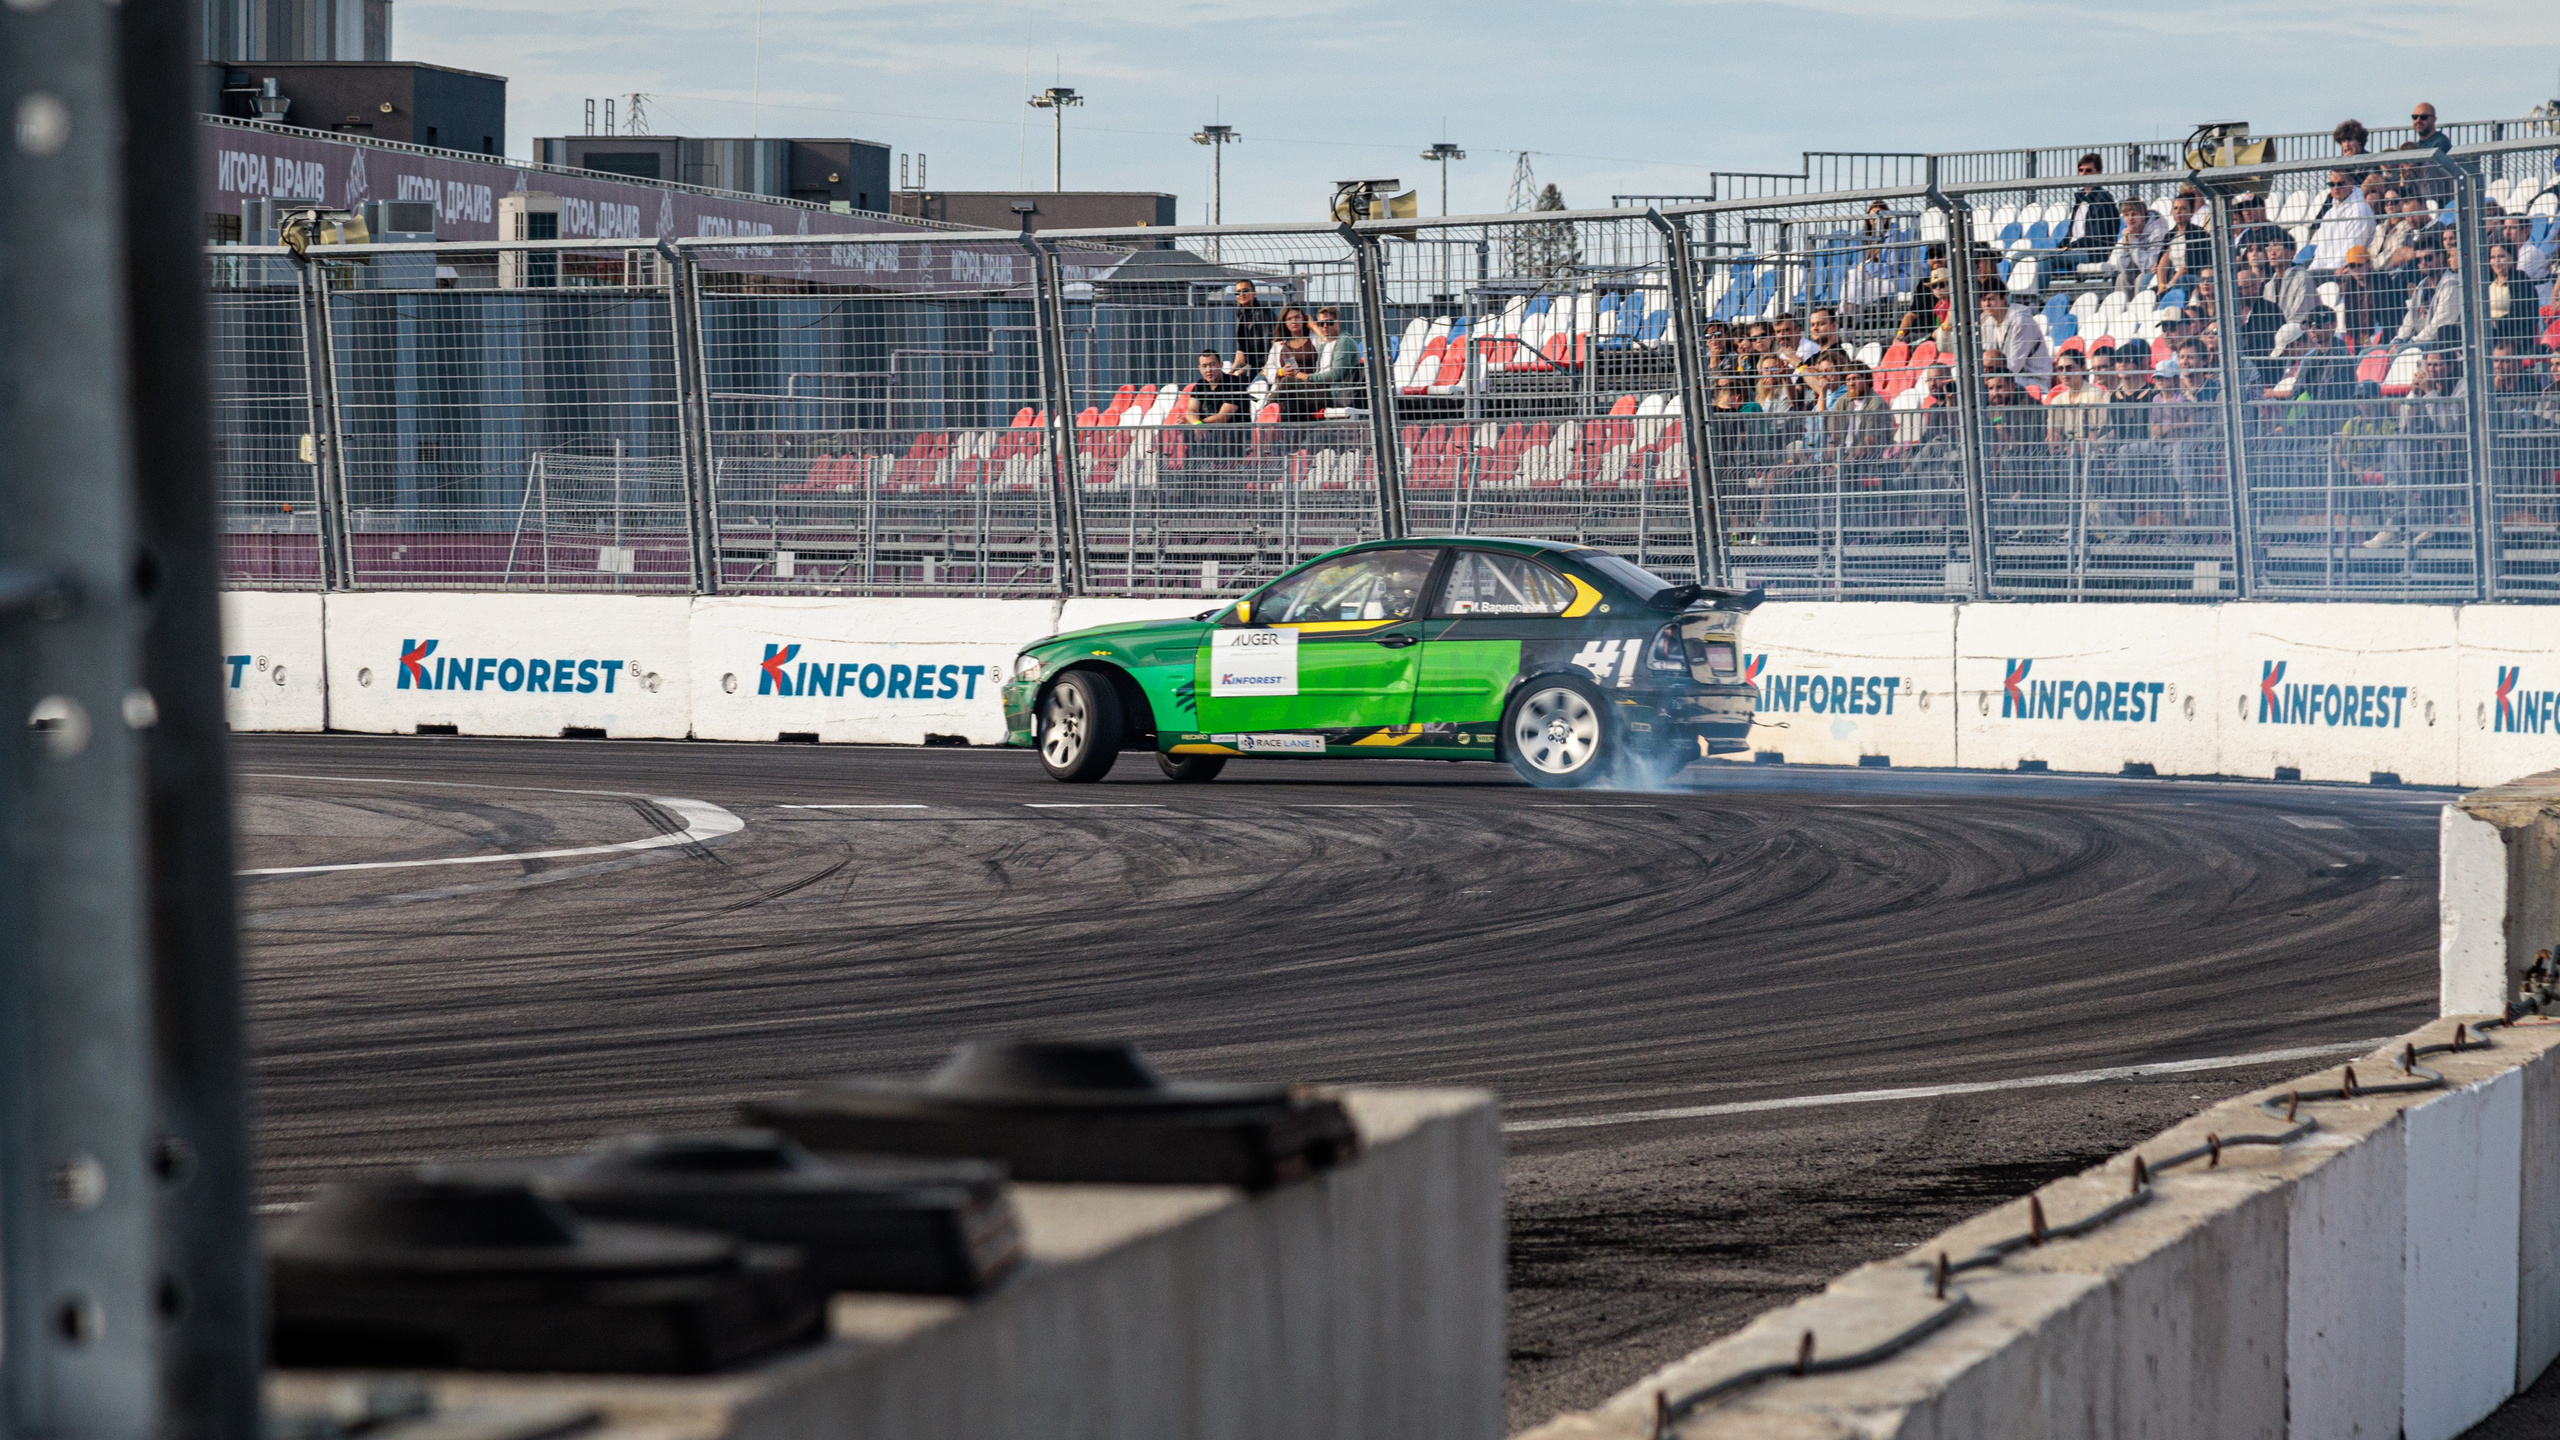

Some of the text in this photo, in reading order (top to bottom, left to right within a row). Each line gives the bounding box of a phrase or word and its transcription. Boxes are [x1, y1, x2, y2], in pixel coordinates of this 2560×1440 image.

[218, 149, 270, 196] ИГОРА
[398, 174, 443, 218] ИГОРА
[951, 249, 982, 283] ИГОРА
[1230, 633, 1279, 646] AUGER
[396, 638, 624, 694] KINFOREST
[757, 643, 985, 700] KINFOREST
[1221, 673, 1283, 685] KINFOREST
[1742, 654, 1901, 715] KINFOREST
[2001, 658, 2165, 723] KINFOREST
[2258, 660, 2408, 728] KINFOREST
[1256, 739, 1282, 747] RACE
[1283, 740, 1311, 748] LANE
